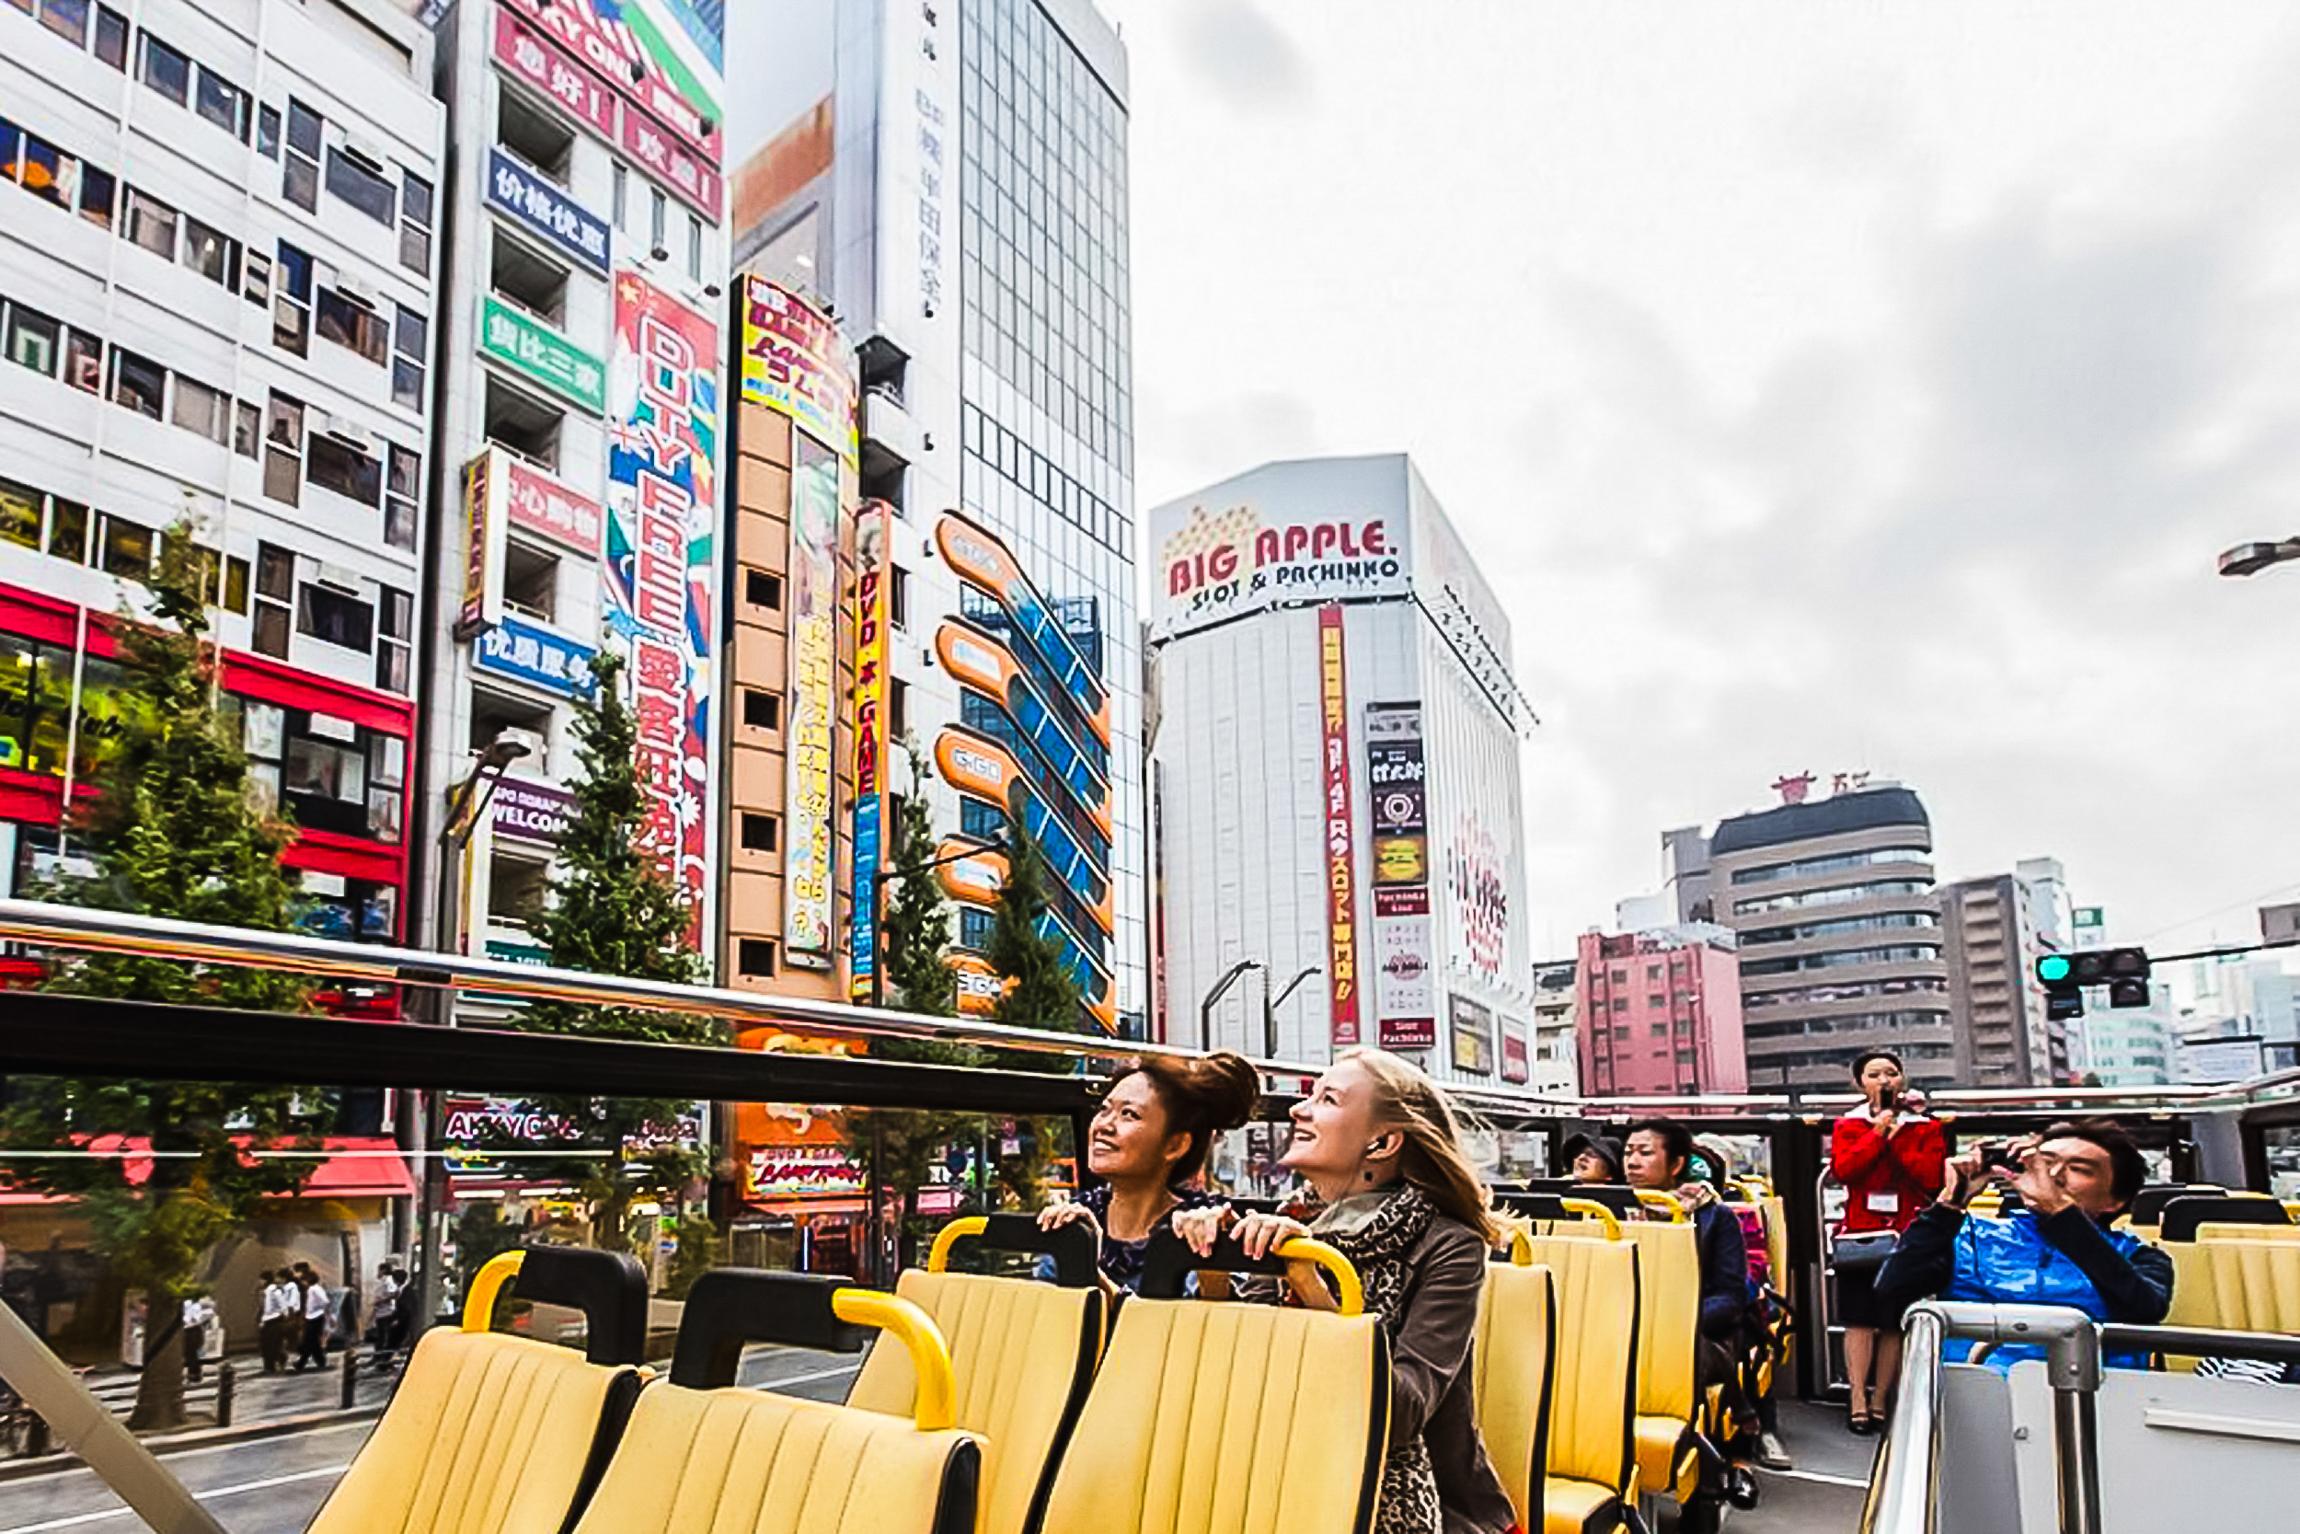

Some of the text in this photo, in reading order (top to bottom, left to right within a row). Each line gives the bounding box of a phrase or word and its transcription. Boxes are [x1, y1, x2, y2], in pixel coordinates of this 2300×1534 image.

[640, 311, 695, 475] DUTY
[1169, 519, 1398, 597] BIG APPLE.
[1192, 559, 1400, 612] SLOT & PACHINKO
[859, 571, 880, 648] DVD
